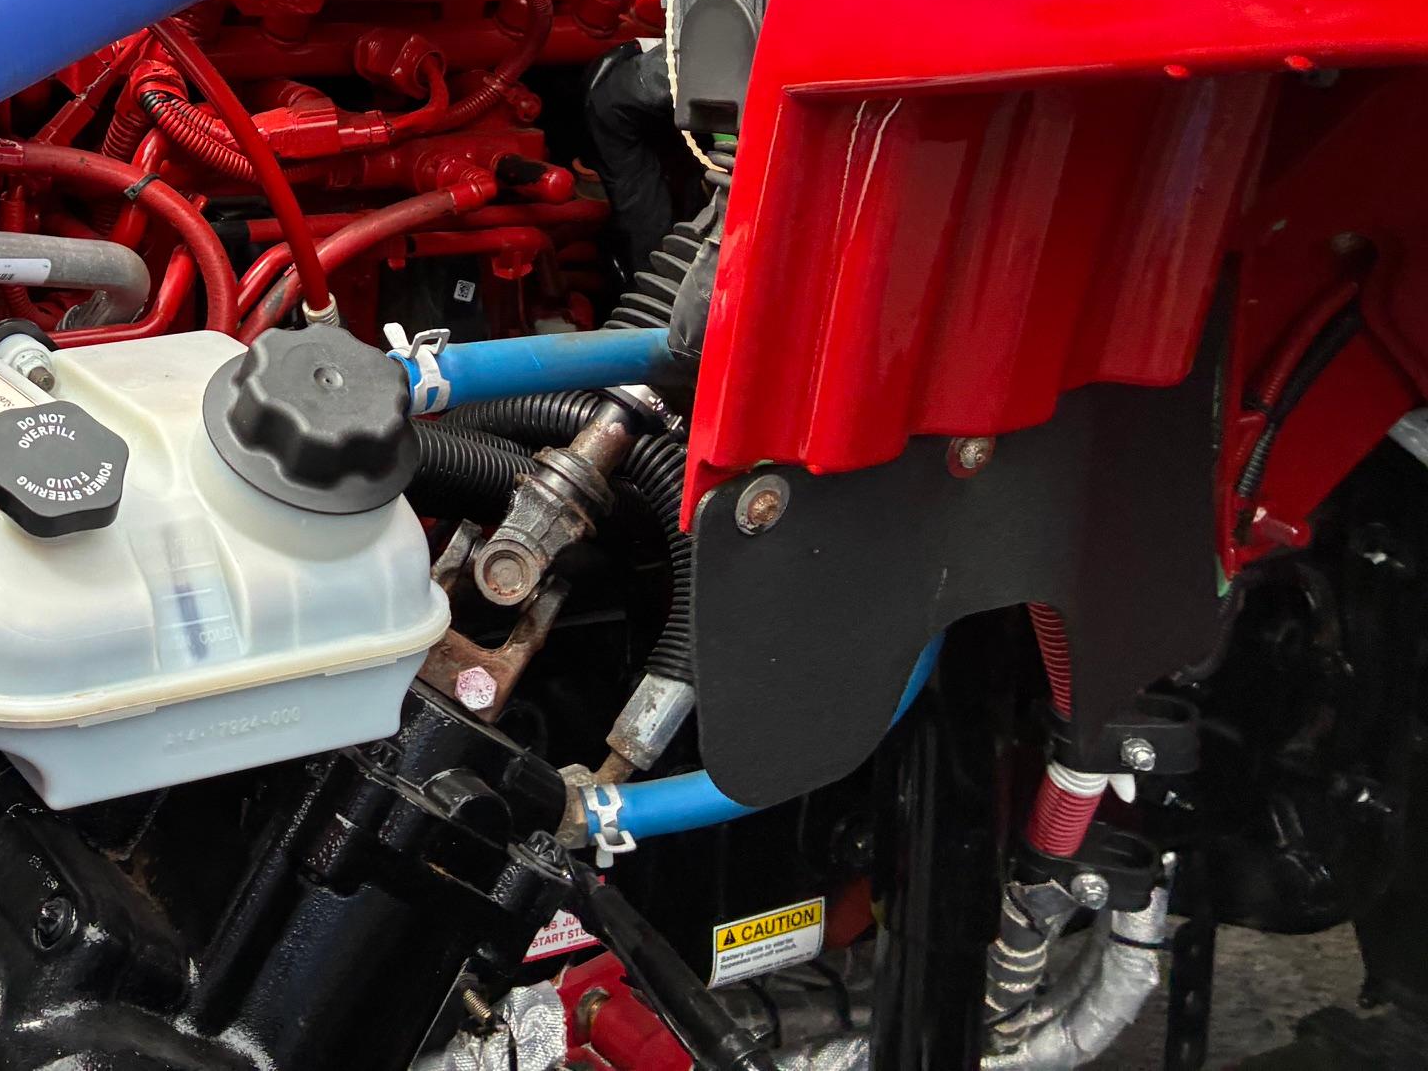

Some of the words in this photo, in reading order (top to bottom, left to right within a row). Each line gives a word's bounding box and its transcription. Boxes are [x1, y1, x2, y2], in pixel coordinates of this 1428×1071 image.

[17, 417, 35, 430] DO
[39, 413, 66, 424] NOT
[18, 425, 76, 449] OVERFILL
[16, 475, 83, 502] STEERING
[46, 471, 90, 489] FLUID
[83, 462, 113, 496] POWER
[741, 907, 815, 941] CAUTION
[532, 931, 565, 949] START
